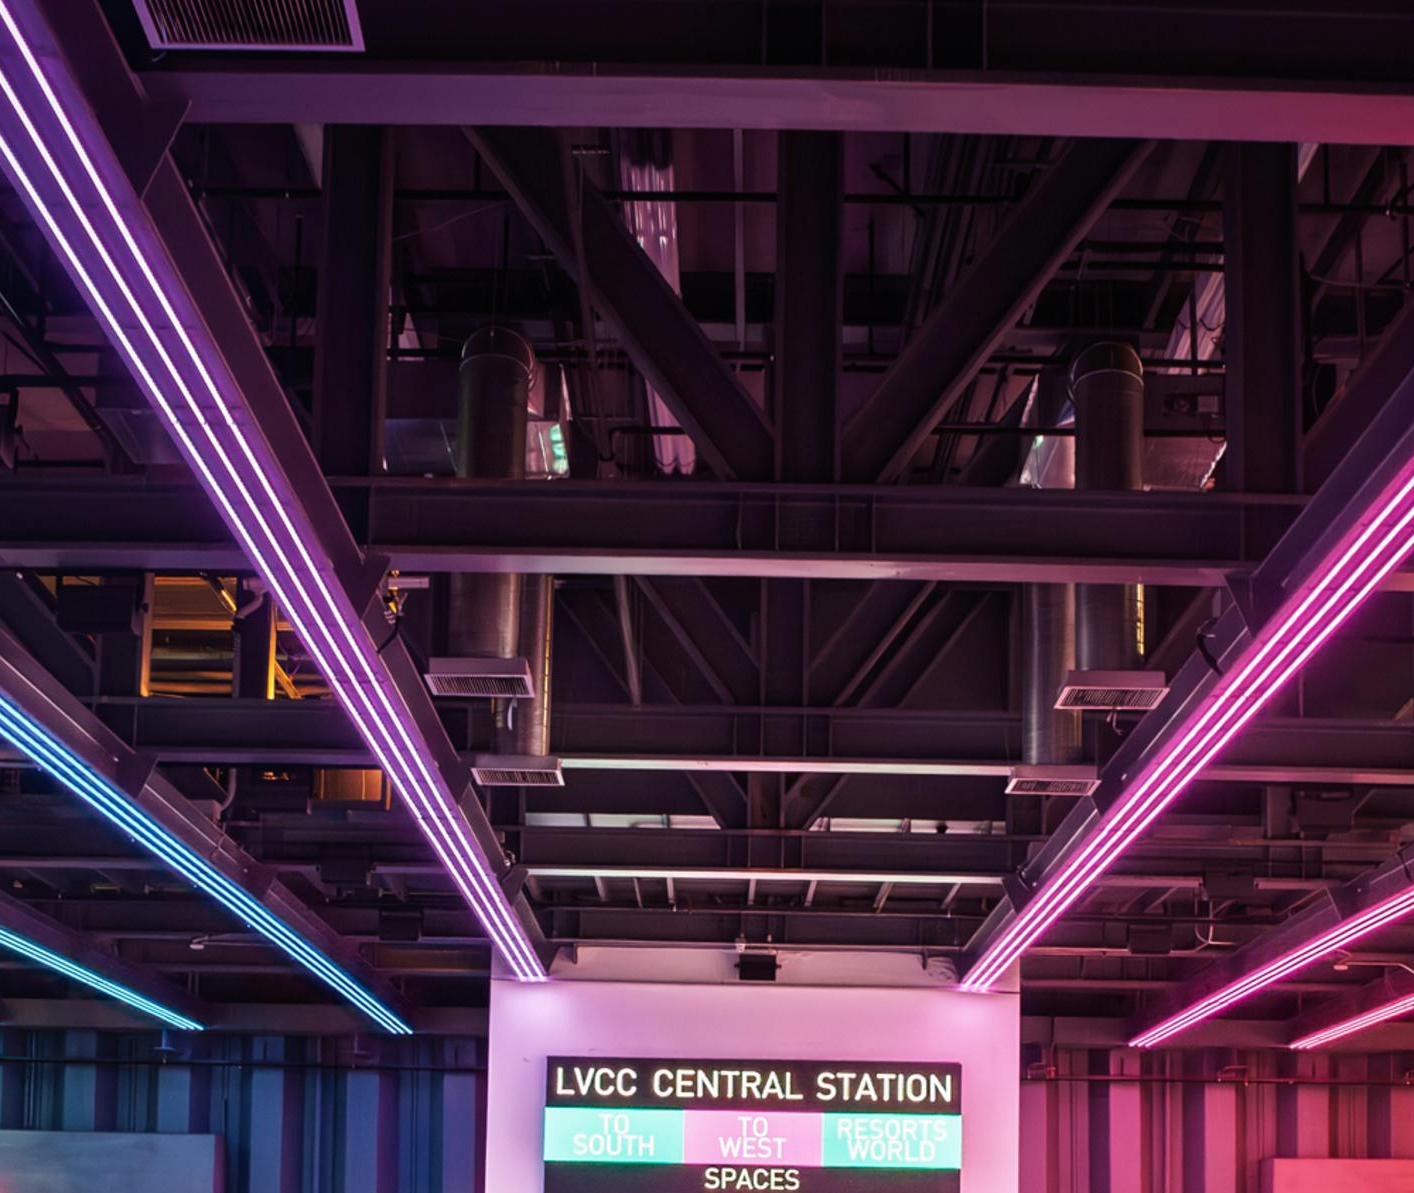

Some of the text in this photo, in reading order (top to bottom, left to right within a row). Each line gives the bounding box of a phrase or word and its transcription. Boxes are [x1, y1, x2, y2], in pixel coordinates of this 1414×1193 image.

[556, 1067, 952, 1102] LVCC CENTRAL STATION
[598, 1113, 629, 1135] TO
[737, 1116, 769, 1138] TO
[837, 1118, 947, 1141] RESORTS
[572, 1134, 654, 1156] SOUTH
[718, 1137, 787, 1158] WEST
[846, 1139, 936, 1161] WORLD
[704, 1167, 800, 1190] SPACES
